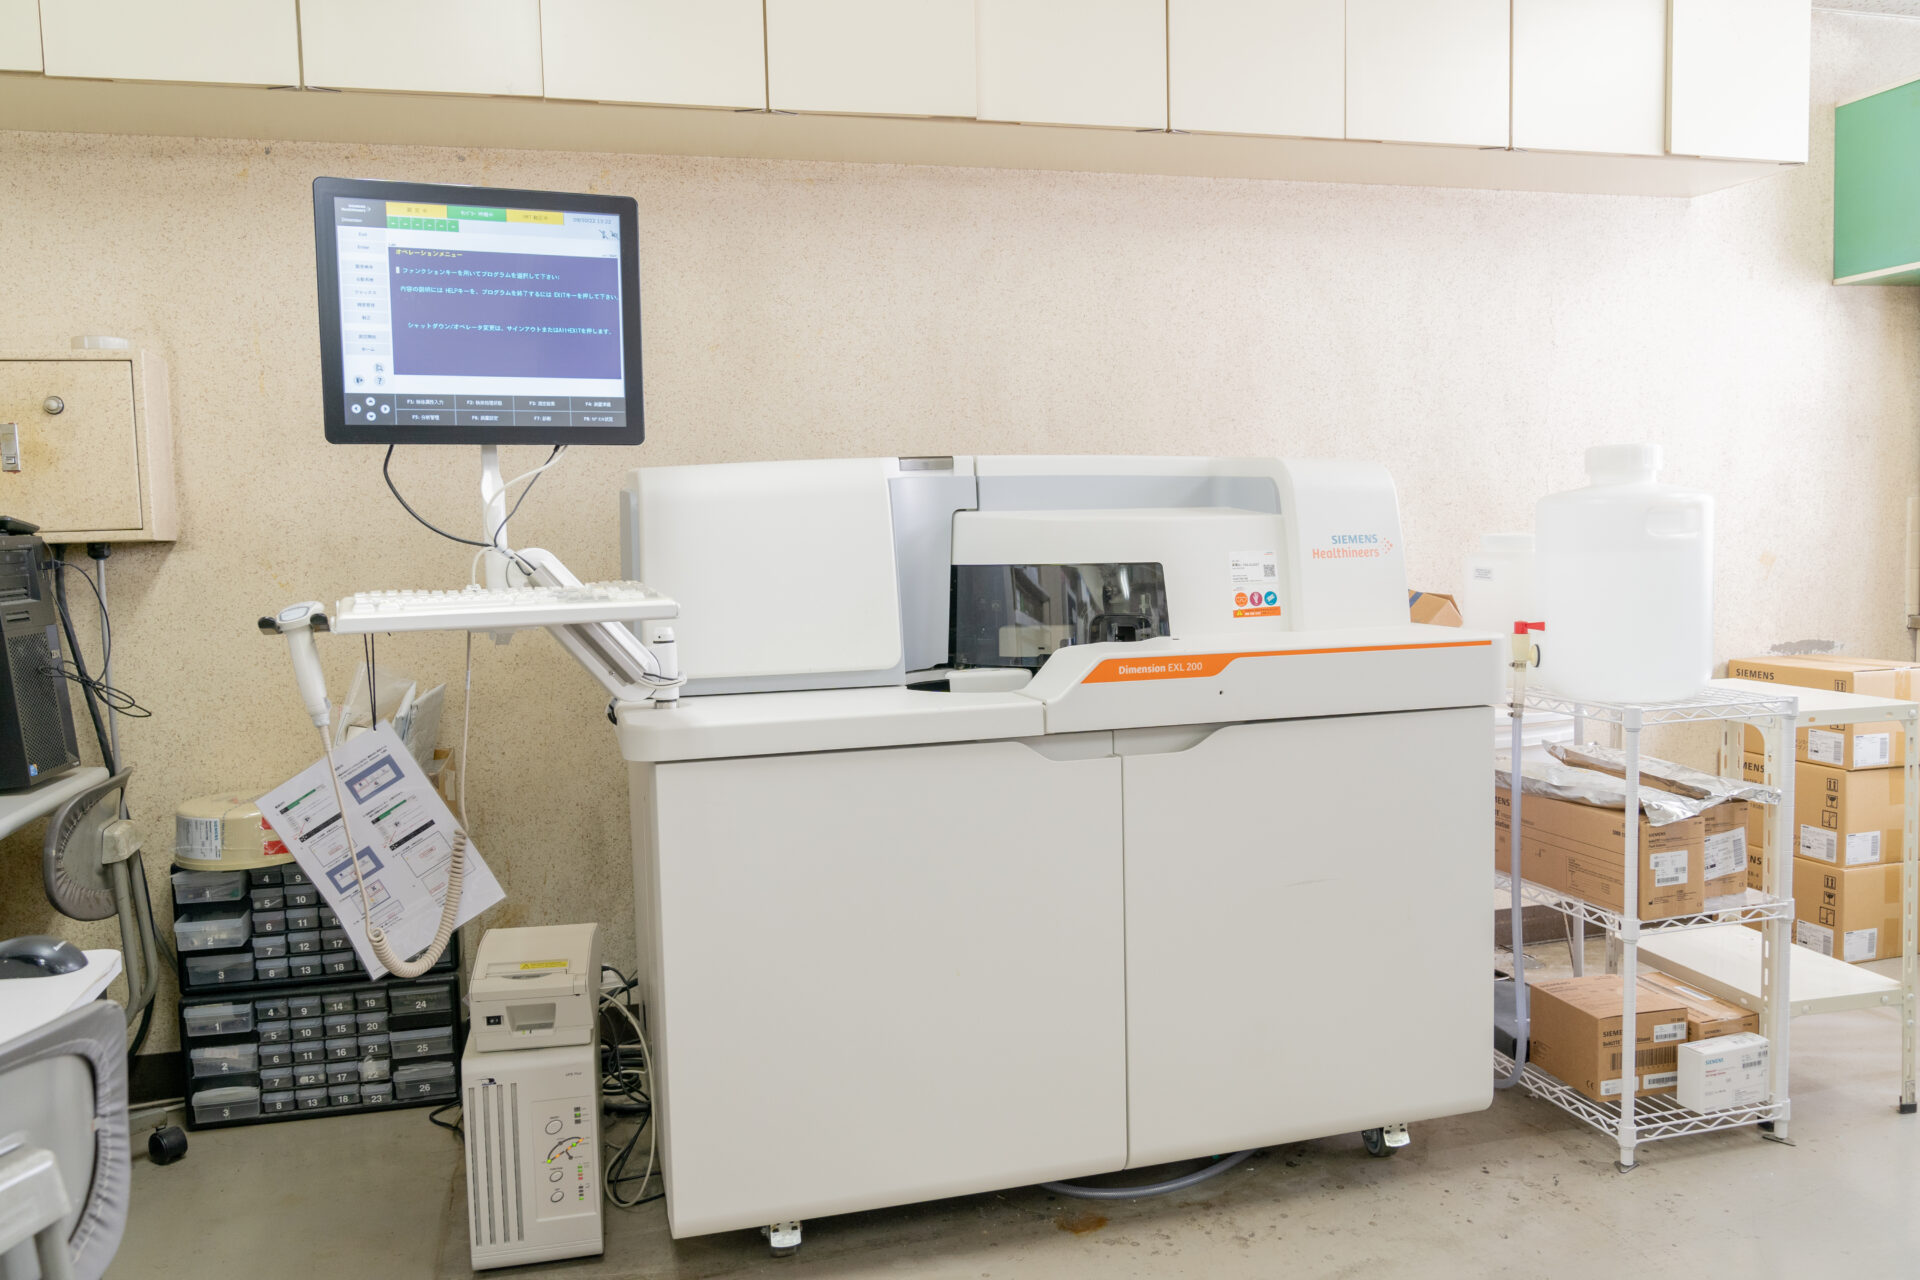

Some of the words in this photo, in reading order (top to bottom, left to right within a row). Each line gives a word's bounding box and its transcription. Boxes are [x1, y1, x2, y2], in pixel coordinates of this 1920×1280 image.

[1331, 534, 1378, 545] SIEMENS
[1312, 547, 1379, 559] Healthineers
[1118, 664, 1166, 675] Dimension
[1168, 663, 1184, 672] EXL
[1186, 662, 1203, 671] 200
[1736, 668, 1775, 680] SIEMENS
[1743, 761, 1765, 773] MENS
[263, 874, 269, 883] 4
[295, 874, 301, 882] 9
[205, 890, 210, 898] 1
[264, 899, 270, 908] 5
[296, 896, 306, 904] 10
[266, 923, 272, 931] 6
[298, 919, 307, 927] 11
[207, 937, 214, 945] 2
[332, 939, 343, 948] 17
[299, 942, 310, 951] 12
[266, 948, 272, 956] 7
[300, 966, 311, 975] 13
[334, 963, 345, 972] 18
[218, 971, 225, 980] 3
[269, 969, 275, 978] 8
[216, 1023, 219, 1031] 1
[1603, 1029, 1623, 1038] SIEME
[417, 1044, 428, 1052] 25
